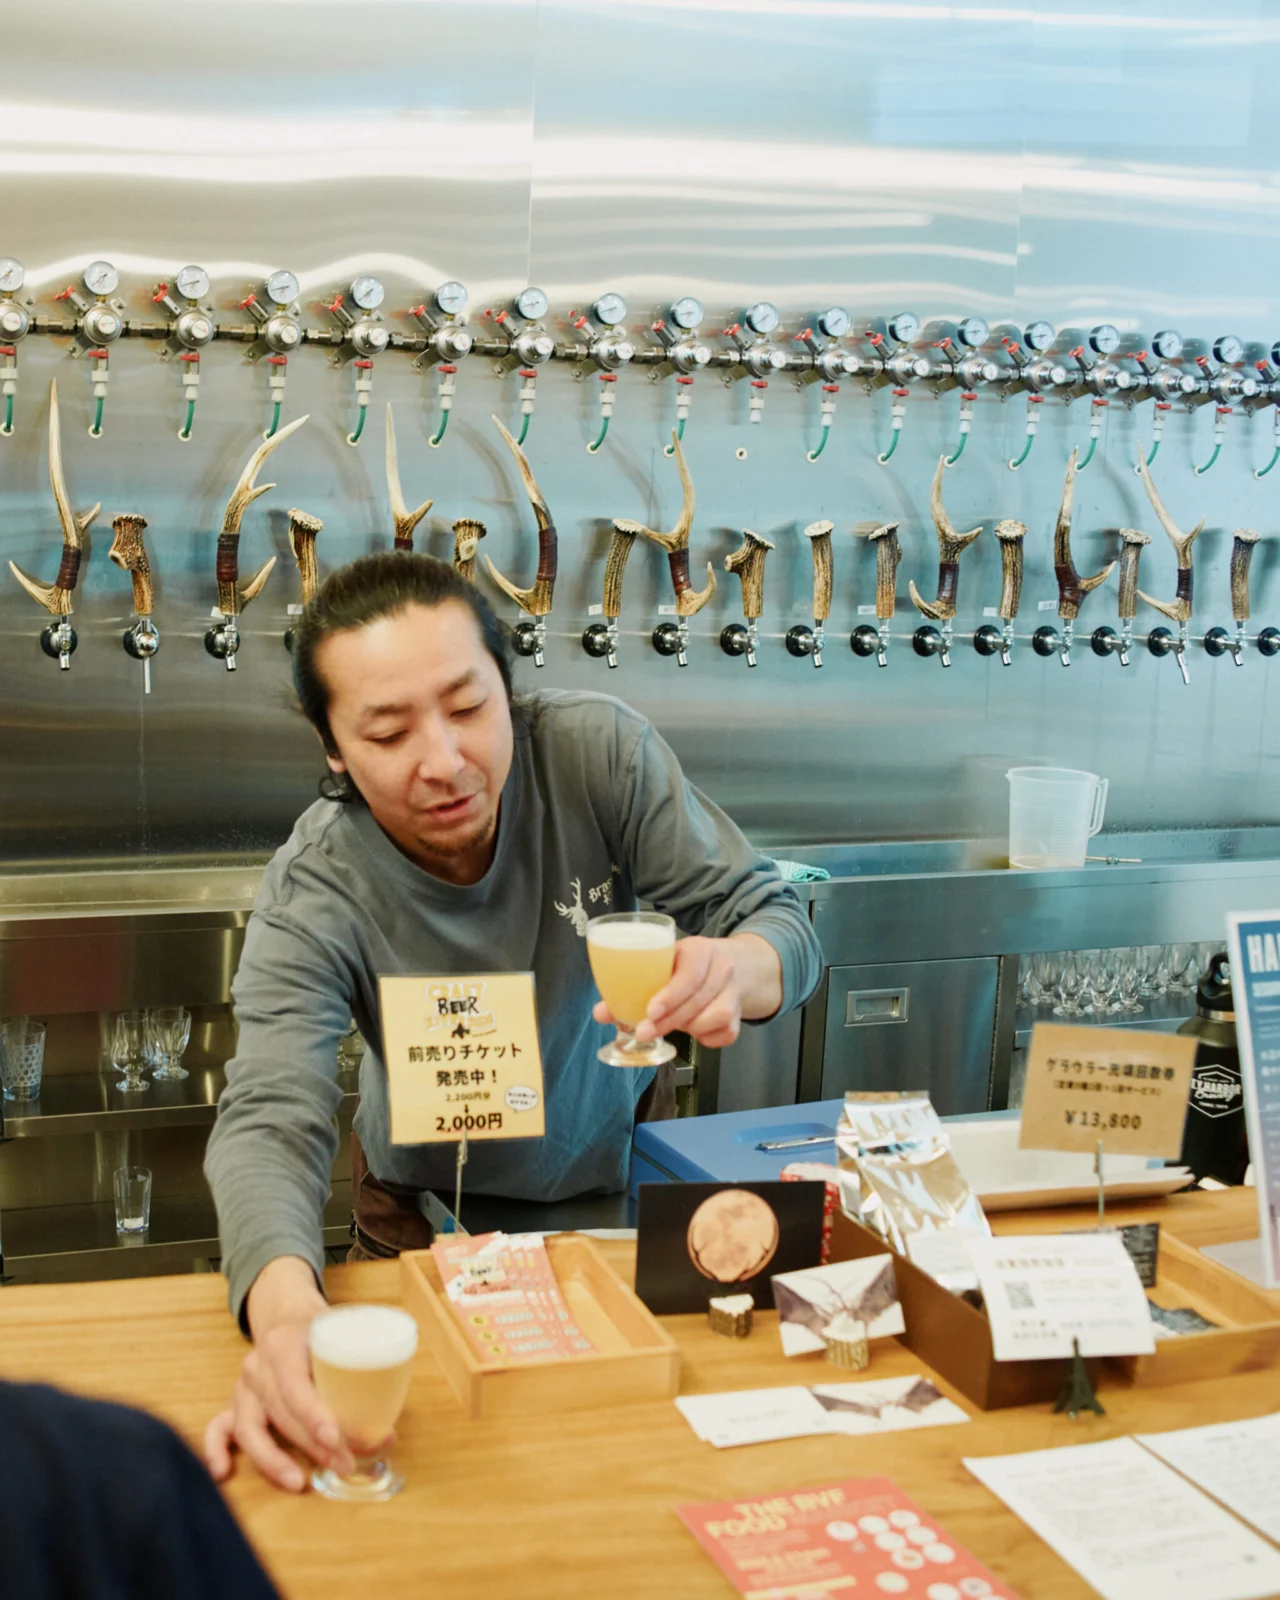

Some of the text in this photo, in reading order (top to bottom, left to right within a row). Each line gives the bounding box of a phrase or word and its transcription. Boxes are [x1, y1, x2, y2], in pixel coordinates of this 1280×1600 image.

[1246, 932, 1280, 974] HA
[437, 996, 480, 1015] BEER
[408, 1043, 522, 1063] 前売りチケット
[436, 1069, 497, 1087] 発売中！
[435, 1112, 503, 1133] 2,000円
[1064, 1109, 1142, 1131] ¥13,800
